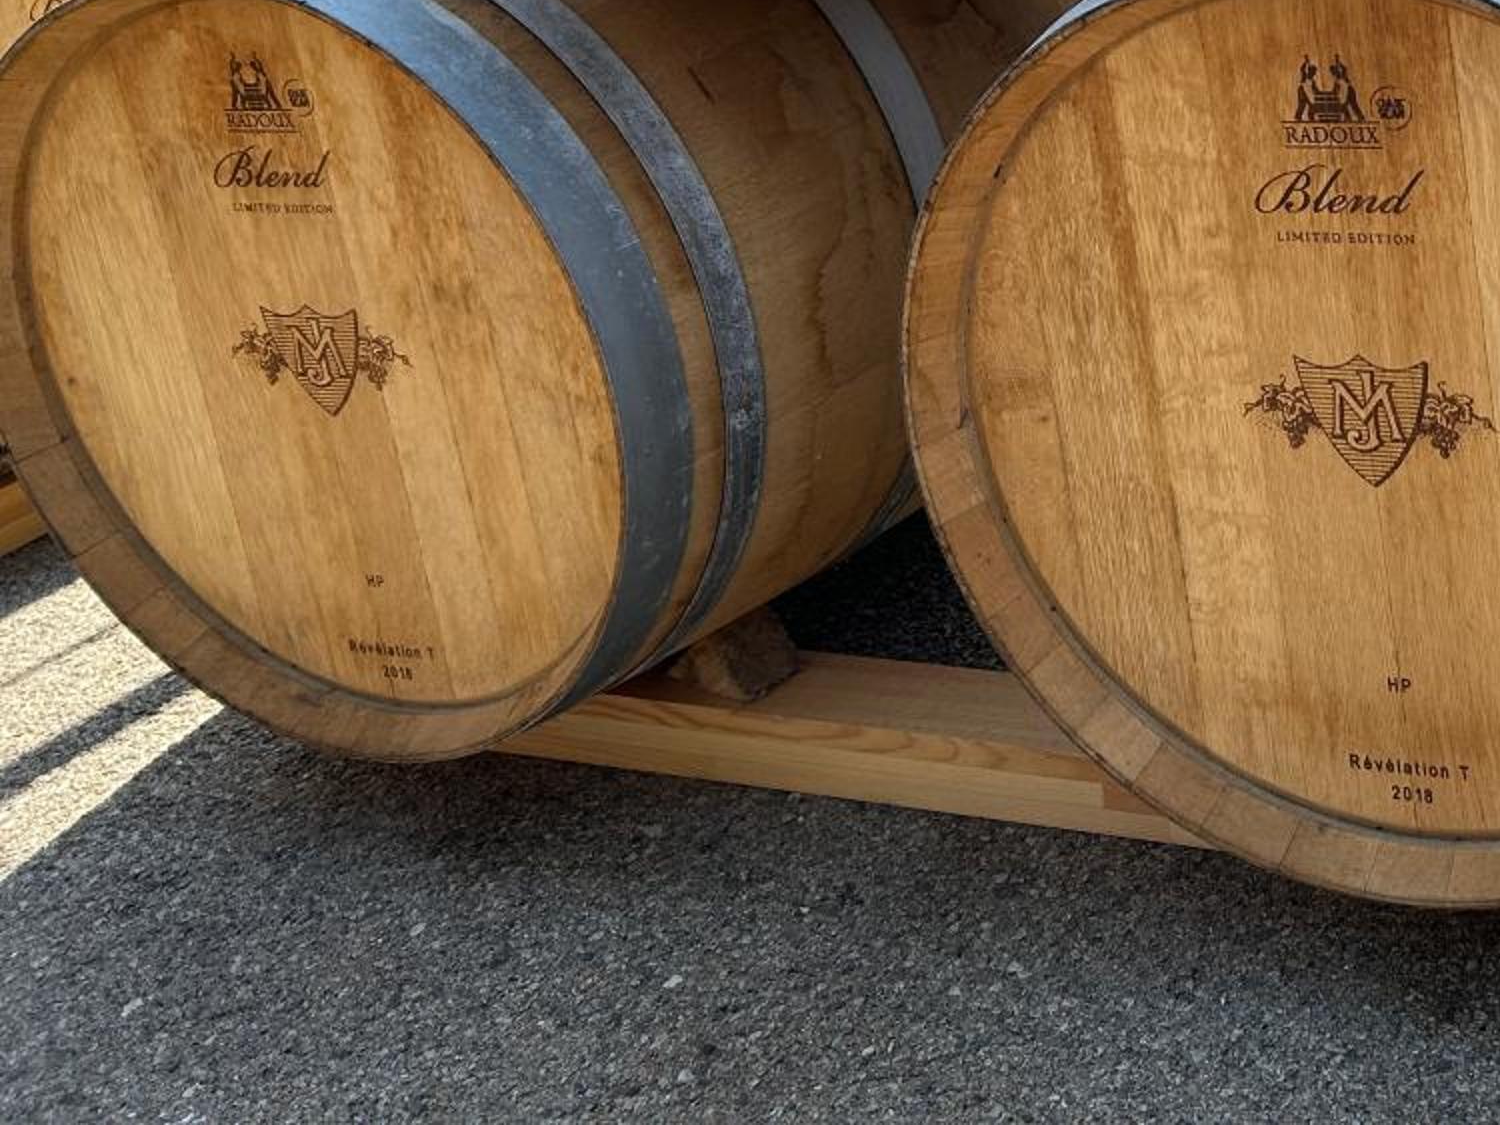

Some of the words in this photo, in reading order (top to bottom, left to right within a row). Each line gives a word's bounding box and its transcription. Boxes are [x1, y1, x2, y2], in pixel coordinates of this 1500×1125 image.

[226, 113, 295, 128] RADOUX
[1284, 126, 1380, 144] RADOUX
[213, 145, 331, 188] Blend
[1254, 162, 1425, 215] Blend
[1276, 230, 1343, 244] LIMITED
[1348, 232, 1416, 246] EDITION
[365, 574, 384, 588] HP
[1387, 676, 1412, 693] HP
[1348, 753, 1449, 779] Révélation
[1459, 764, 1470, 781] T
[1391, 784, 1434, 803] 2018
